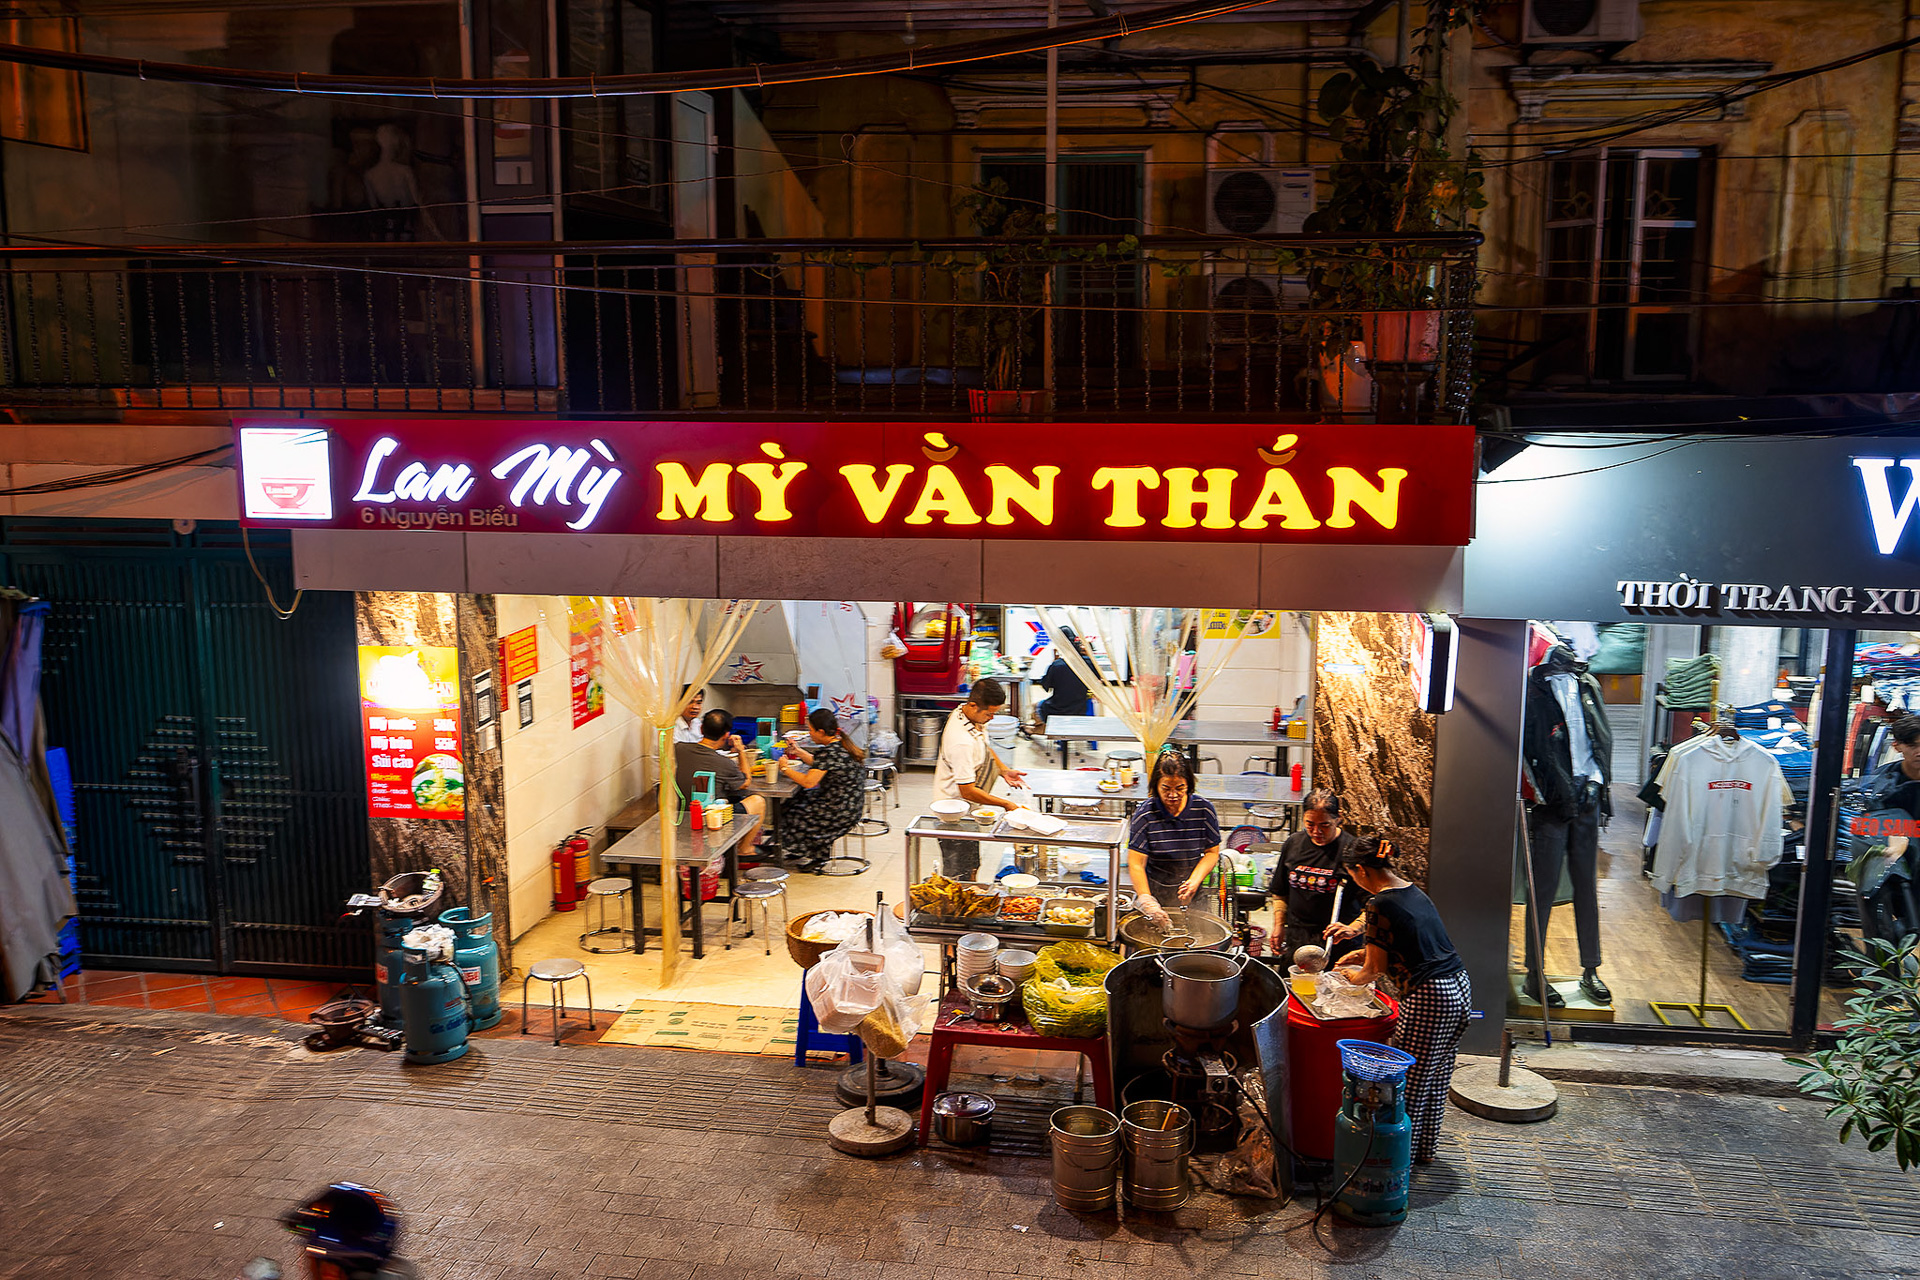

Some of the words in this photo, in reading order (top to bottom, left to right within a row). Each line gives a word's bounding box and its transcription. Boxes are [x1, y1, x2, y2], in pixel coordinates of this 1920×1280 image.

[352, 436, 478, 503] Lan
[490, 438, 622, 530] Mỳ
[655, 441, 808, 522] MỲ
[361, 506, 375, 525] 6
[380, 504, 464, 529] Nguyễn
[469, 504, 518, 527] Biểu
[1616, 572, 1713, 609] THỜI
[1720, 584, 1856, 613] TRANG
